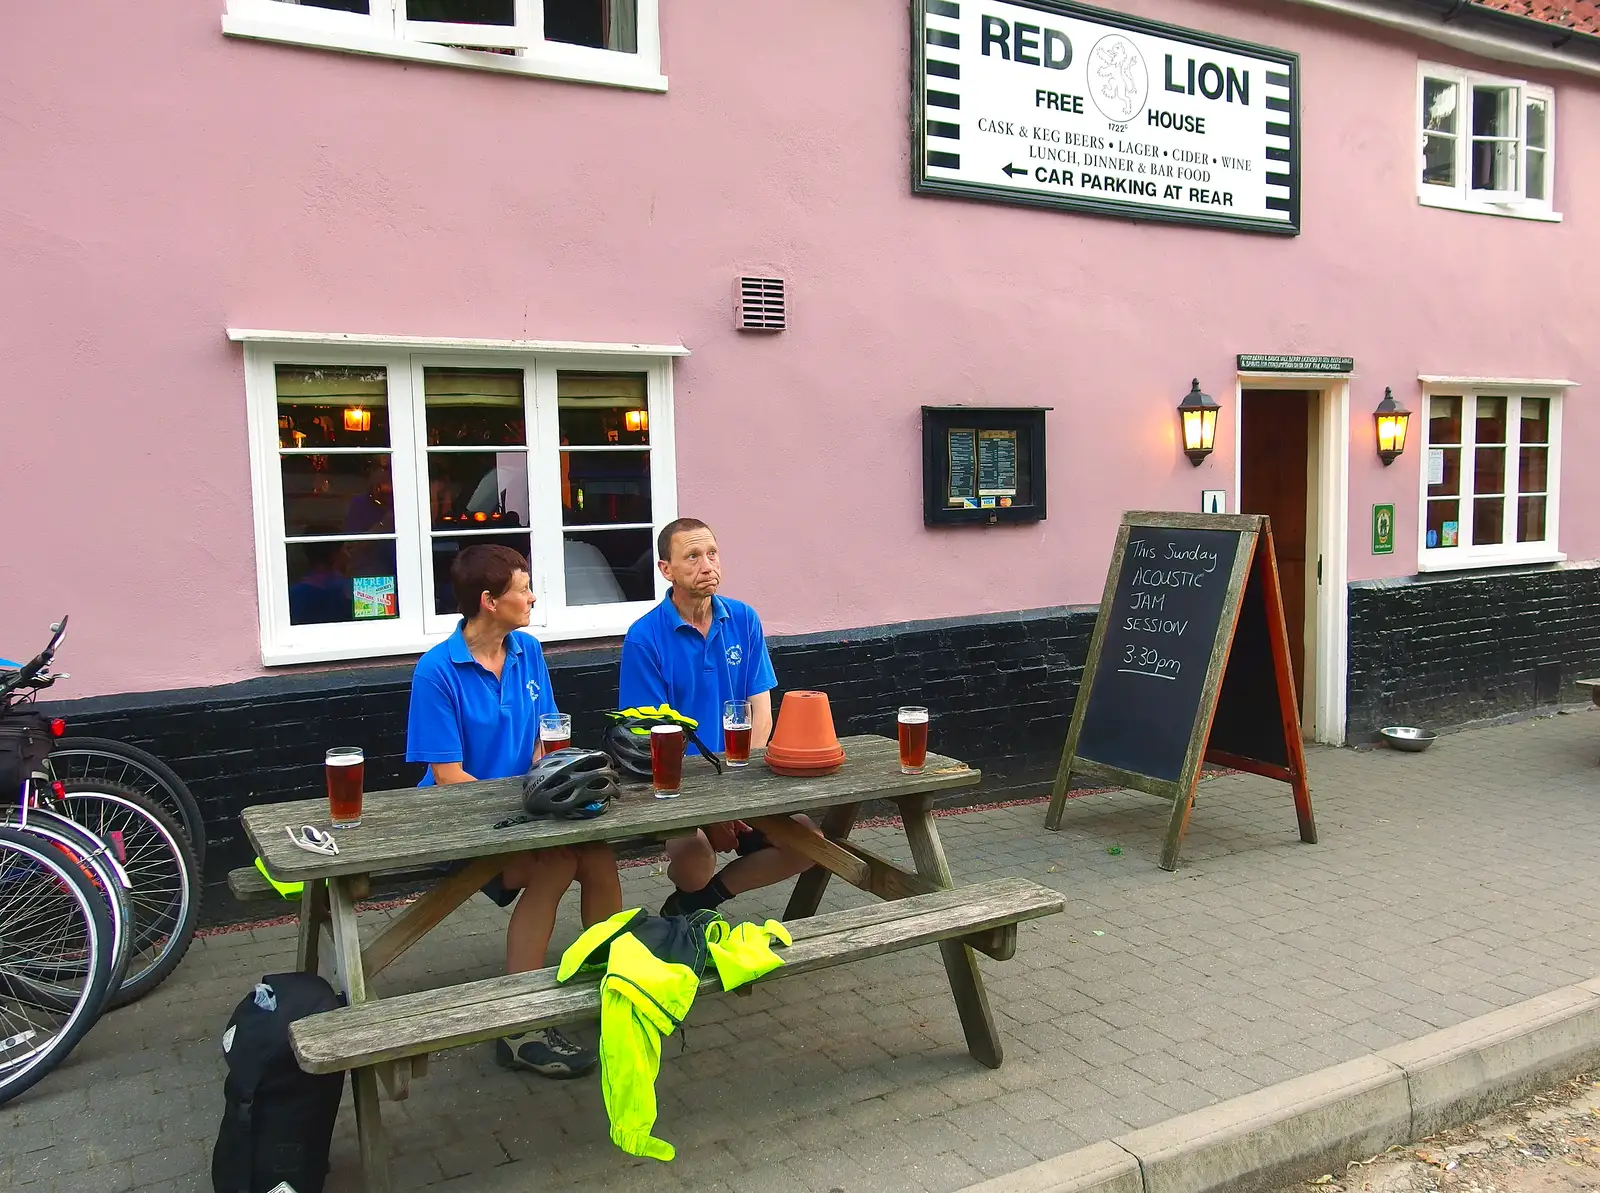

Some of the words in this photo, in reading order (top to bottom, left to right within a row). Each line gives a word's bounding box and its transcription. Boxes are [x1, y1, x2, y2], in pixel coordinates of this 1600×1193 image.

[981, 14, 1073, 71] RED
[1164, 53, 1250, 106] LION
[1035, 89, 1084, 115] FREE
[1147, 108, 1206, 135] HOUSE
[978, 117, 1015, 136] CASK
[1019, 126, 1029, 139] &
[1033, 126, 1061, 143] KEG
[1065, 132, 1105, 150] BEERS
[1118, 140, 1159, 158] LAGER
[1172, 148, 1209, 165] CIDER
[1221, 156, 1252, 172] WINE
[1029, 144, 1081, 168] LUNCH,
[1084, 152, 1134, 172] DINNER
[1137, 161, 1147, 174] &
[1150, 162, 1174, 178] BAR
[1177, 166, 1211, 183] FOOD
[1035, 166, 1074, 187] CAR
[1081, 172, 1157, 198] PARKING
[1163, 184, 1182, 200] AT
[1189, 187, 1233, 207] REAR
[1130, 540, 1156, 559] This
[1164, 543, 1217, 572] Sunday
[1132, 567, 1204, 587] ACOUSTIC
[1130, 592, 1165, 611] JAM
[1123, 617, 1188, 636] SESSION
